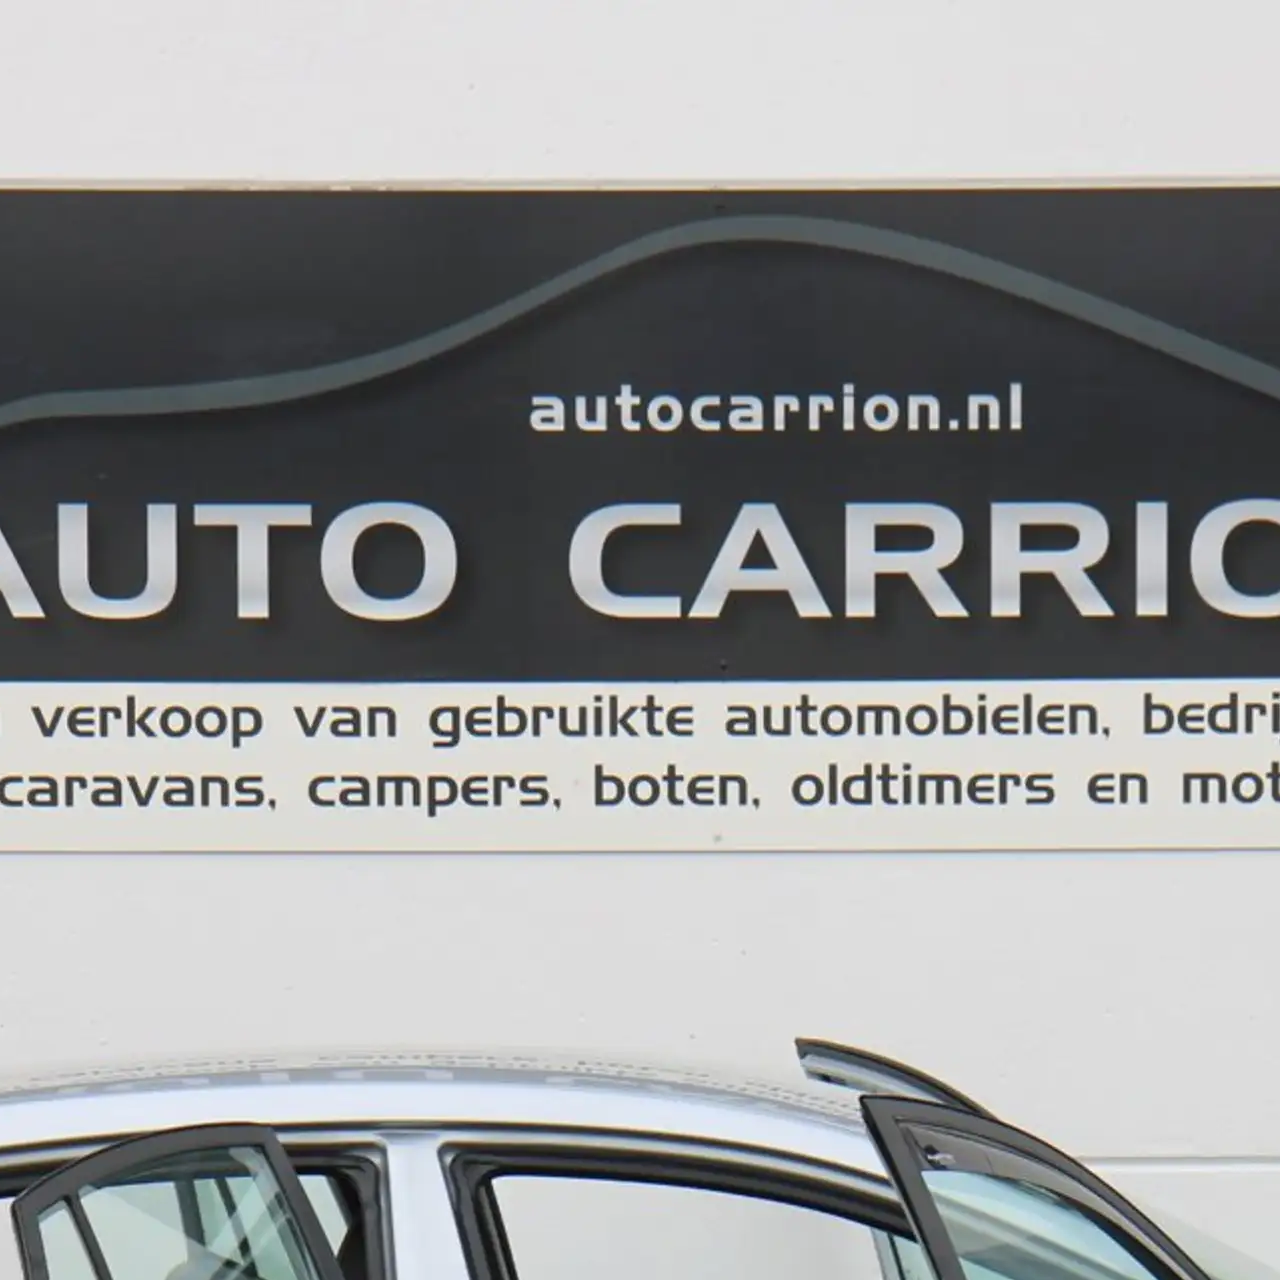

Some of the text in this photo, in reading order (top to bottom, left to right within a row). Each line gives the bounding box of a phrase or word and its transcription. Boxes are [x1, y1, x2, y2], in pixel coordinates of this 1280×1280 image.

[529, 382, 1024, 433] autocarrion.nl
[30, 694, 264, 749] verkoop
[292, 705, 398, 739] van
[428, 694, 695, 748] gebruikte
[724, 693, 1111, 738] automobielen,
[307, 774, 562, 818] campers,
[593, 764, 761, 809] boten,
[790, 762, 1056, 807] oldtimers
[1086, 772, 1149, 805] en
